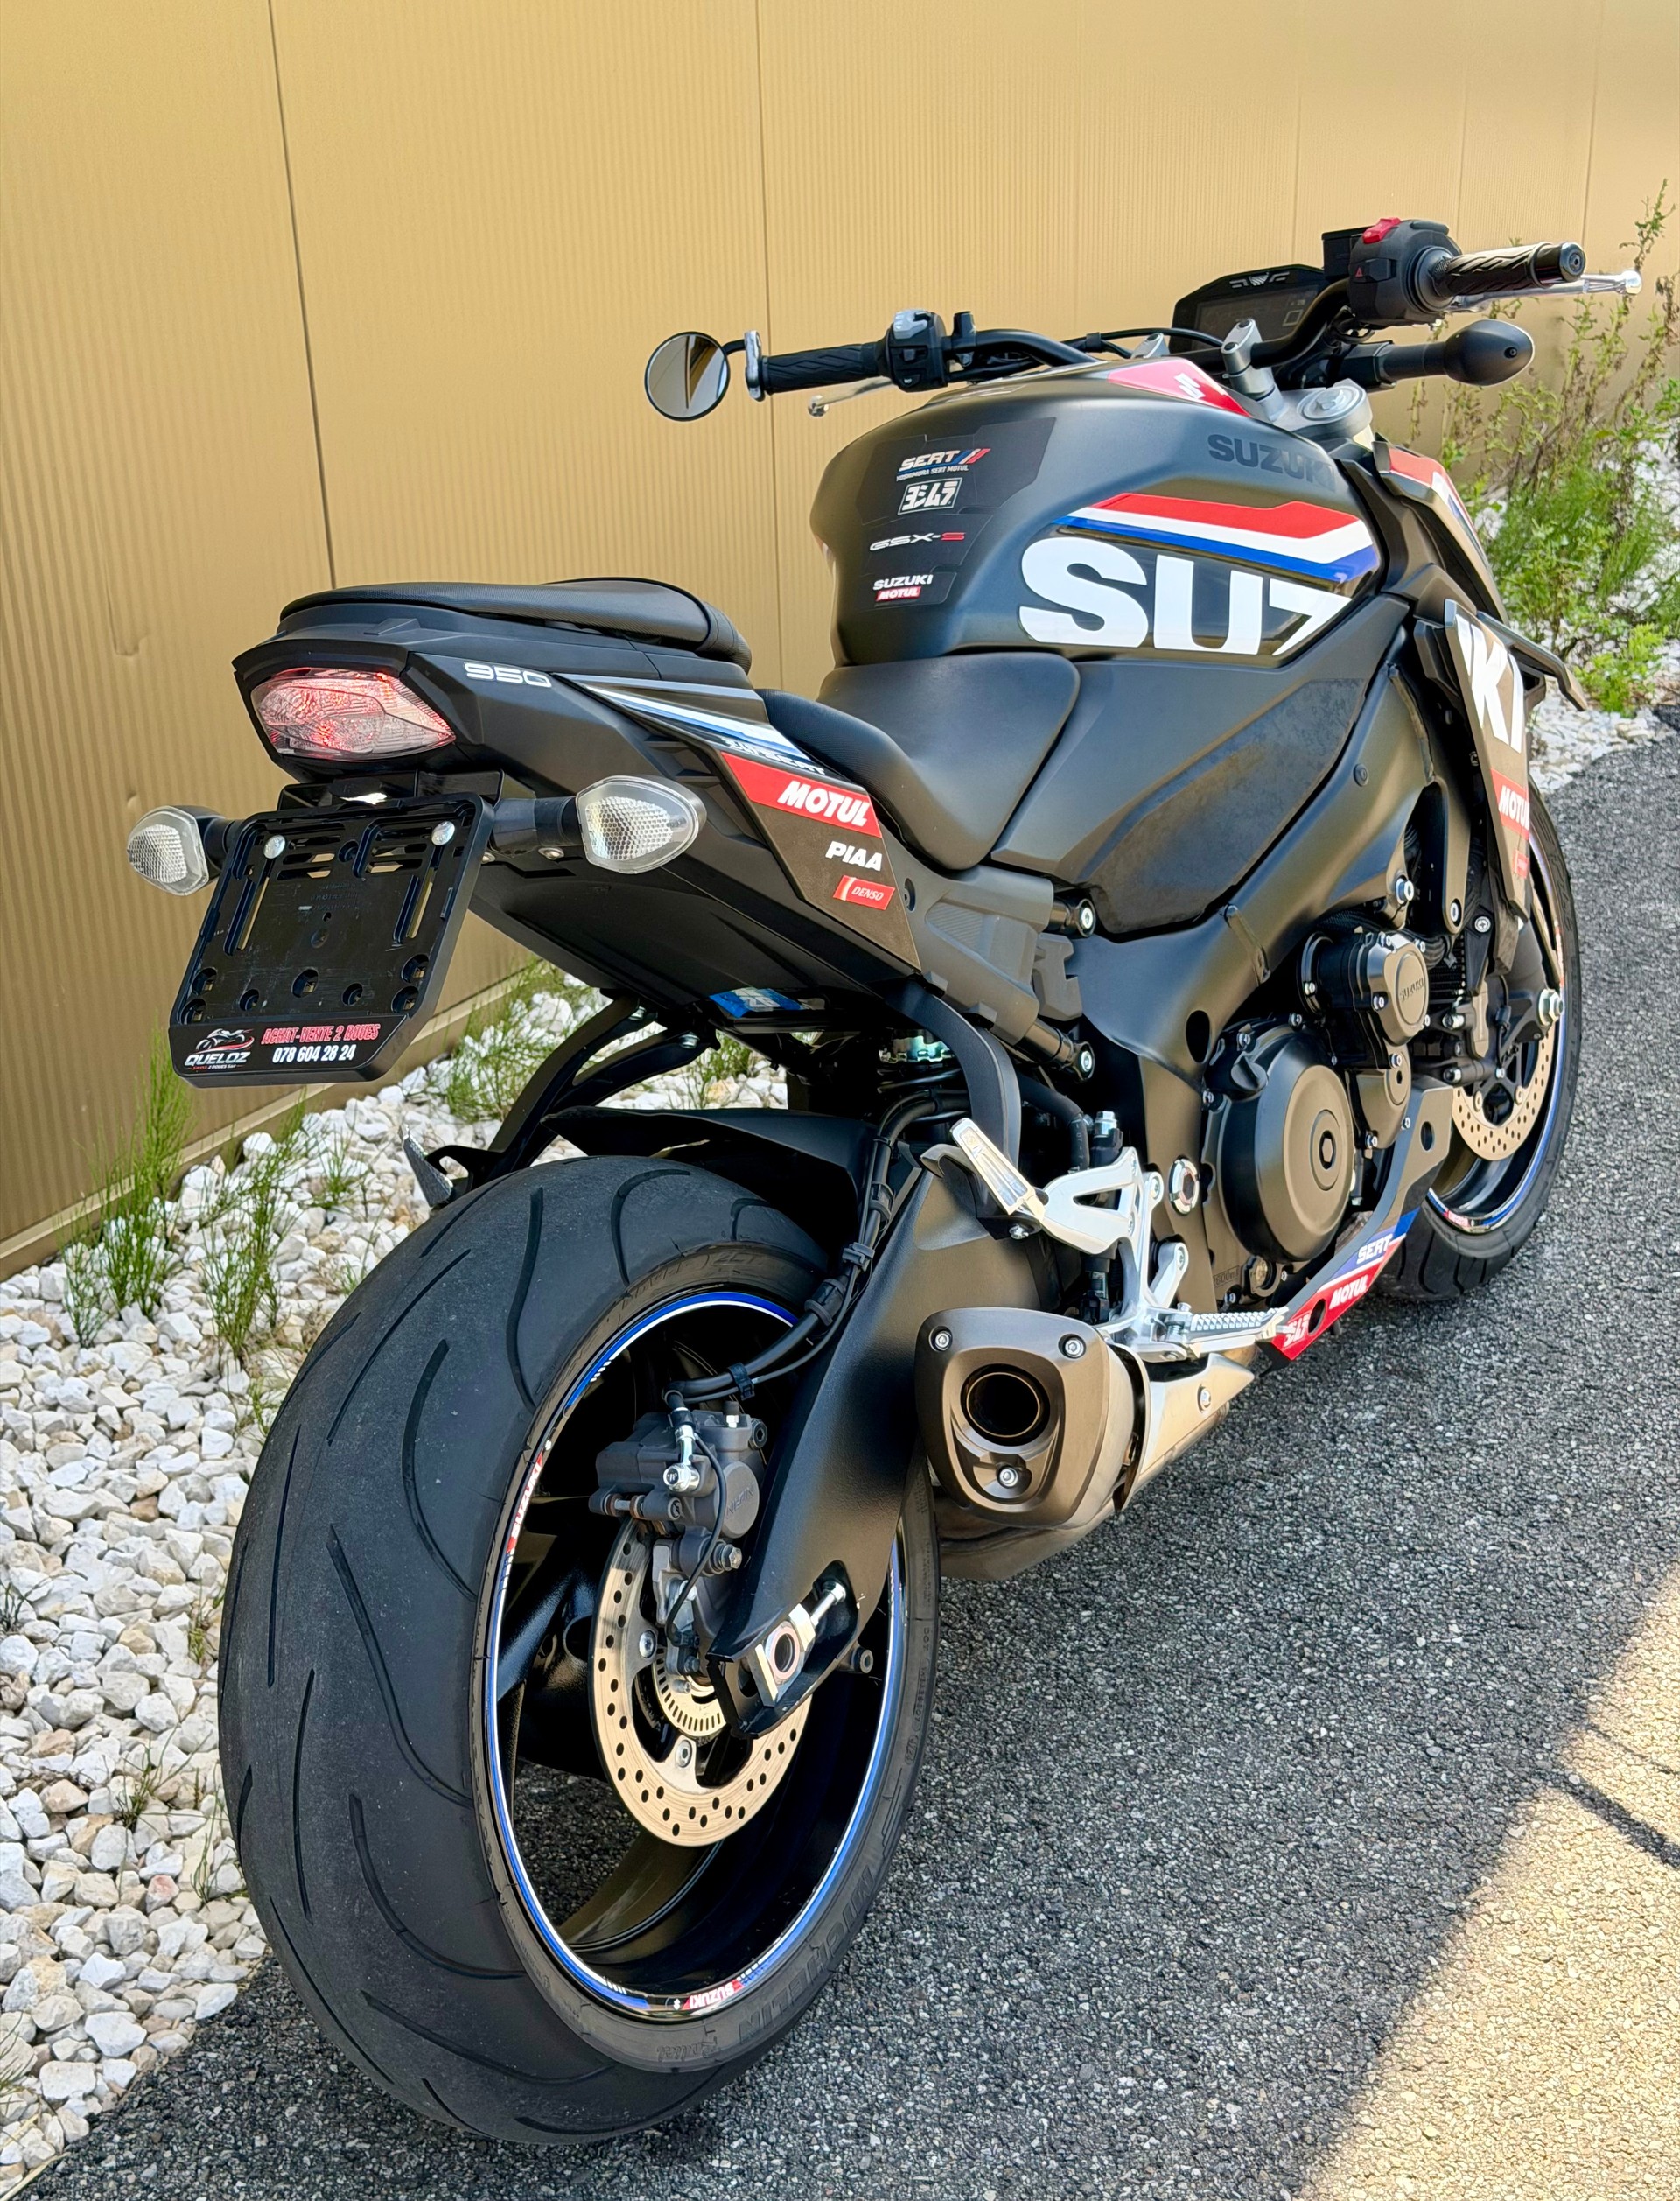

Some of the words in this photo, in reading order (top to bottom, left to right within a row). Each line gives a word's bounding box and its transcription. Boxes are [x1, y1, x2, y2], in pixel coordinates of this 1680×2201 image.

[899, 450, 961, 472] SERT
[930, 466, 947, 475] SERT
[870, 532, 966, 551] GSX-S
[873, 574, 934, 591] SUZUKI
[877, 587, 920, 601] MOTUL
[464, 662, 552, 688] 950
[777, 780, 870, 827] MOTUL
[825, 840, 882, 872] PIAA
[851, 886, 884, 901] DENSO
[261, 1025, 335, 1045] ACHAT-VENTE
[333, 1025, 345, 1041] 2
[343, 1023, 381, 1041] ROUES
[185, 1052, 251, 1066] QUELOZ
[272, 1047, 297, 1063] 078
[297, 1045, 321, 1062] 604
[320, 1044, 339, 1062] 28
[338, 1043, 357, 1061] 24
[1357, 1233, 1393, 1264] SERT
[1329, 1274, 1369, 1310] MOTUL
[511, 1462, 542, 1539] SUZUKI
[689, 1981, 735, 2009] SUZUKI
